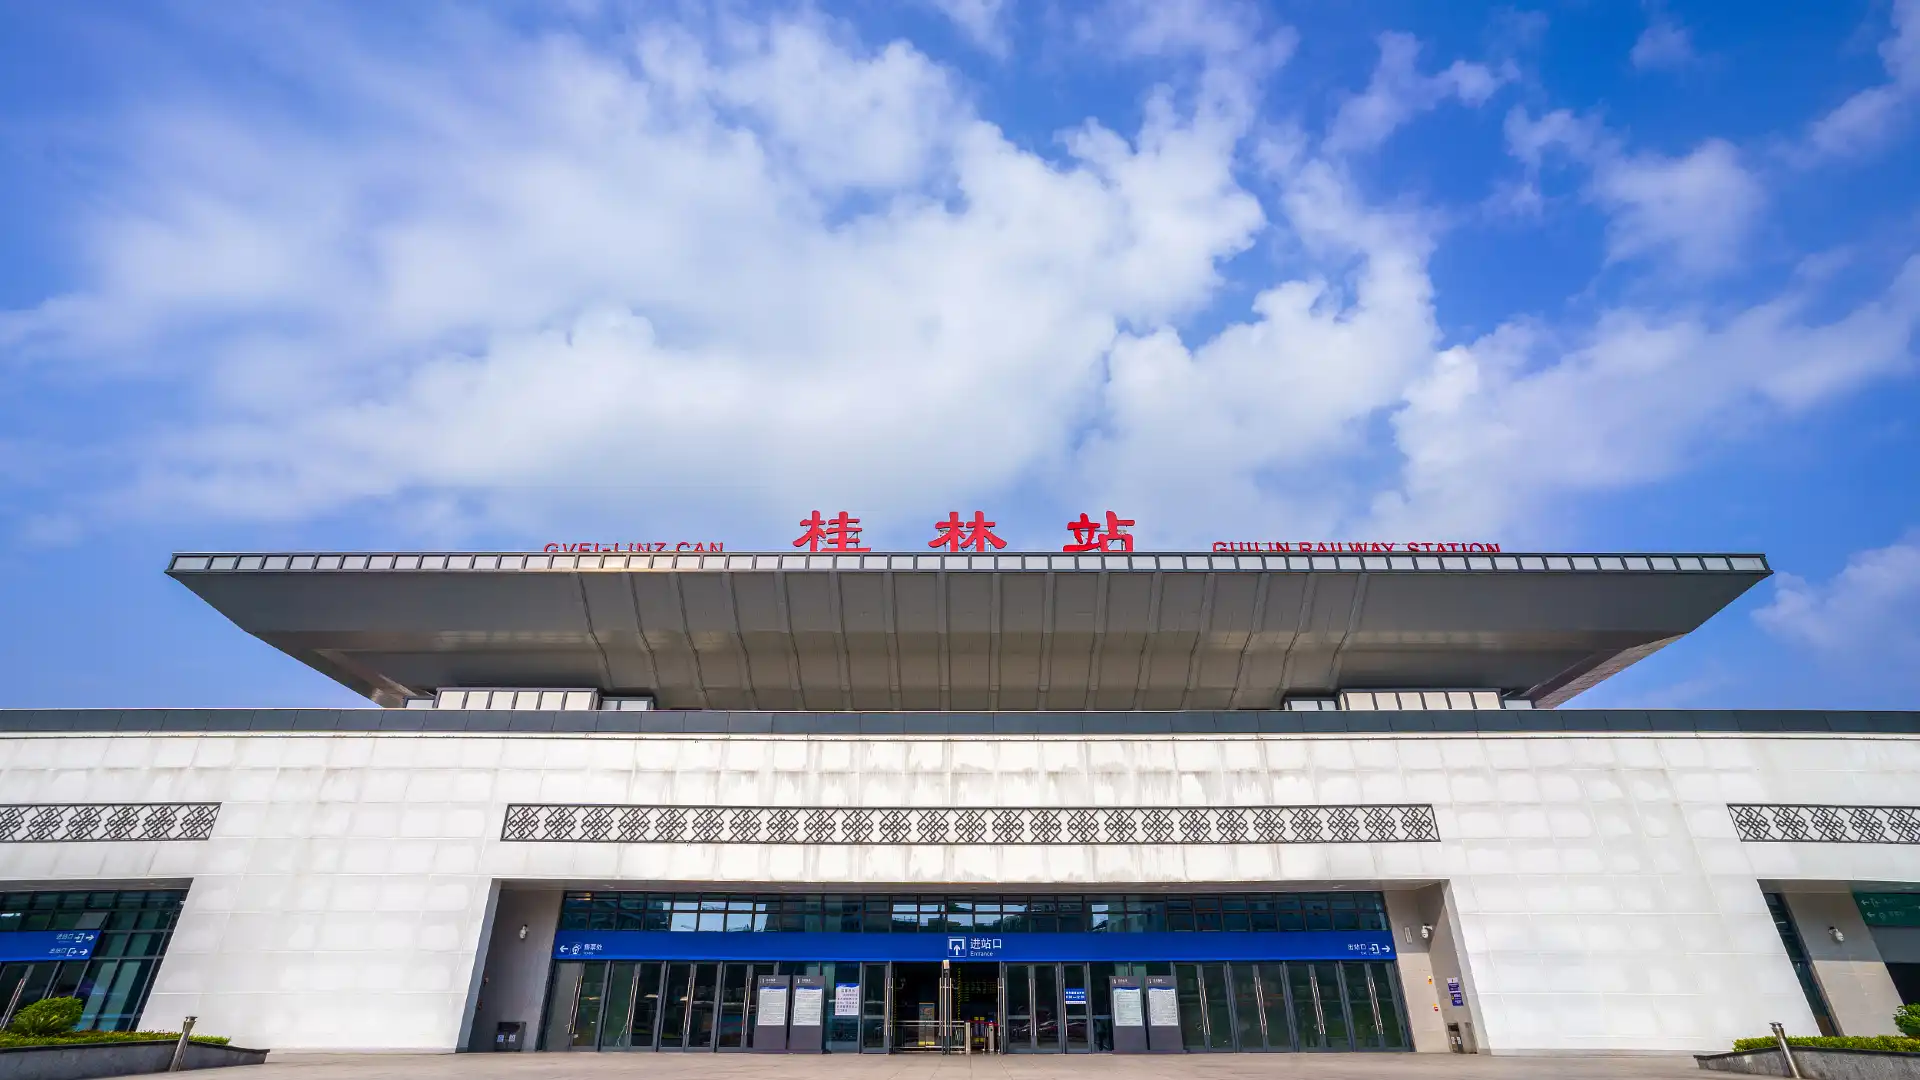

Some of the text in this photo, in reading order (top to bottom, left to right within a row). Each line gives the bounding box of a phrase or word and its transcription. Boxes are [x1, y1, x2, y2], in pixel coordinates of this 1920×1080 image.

[793, 510, 1136, 552] 桂林站
[1407, 541, 1501, 552] STATION
[970, 937, 1002, 950] 进站口
